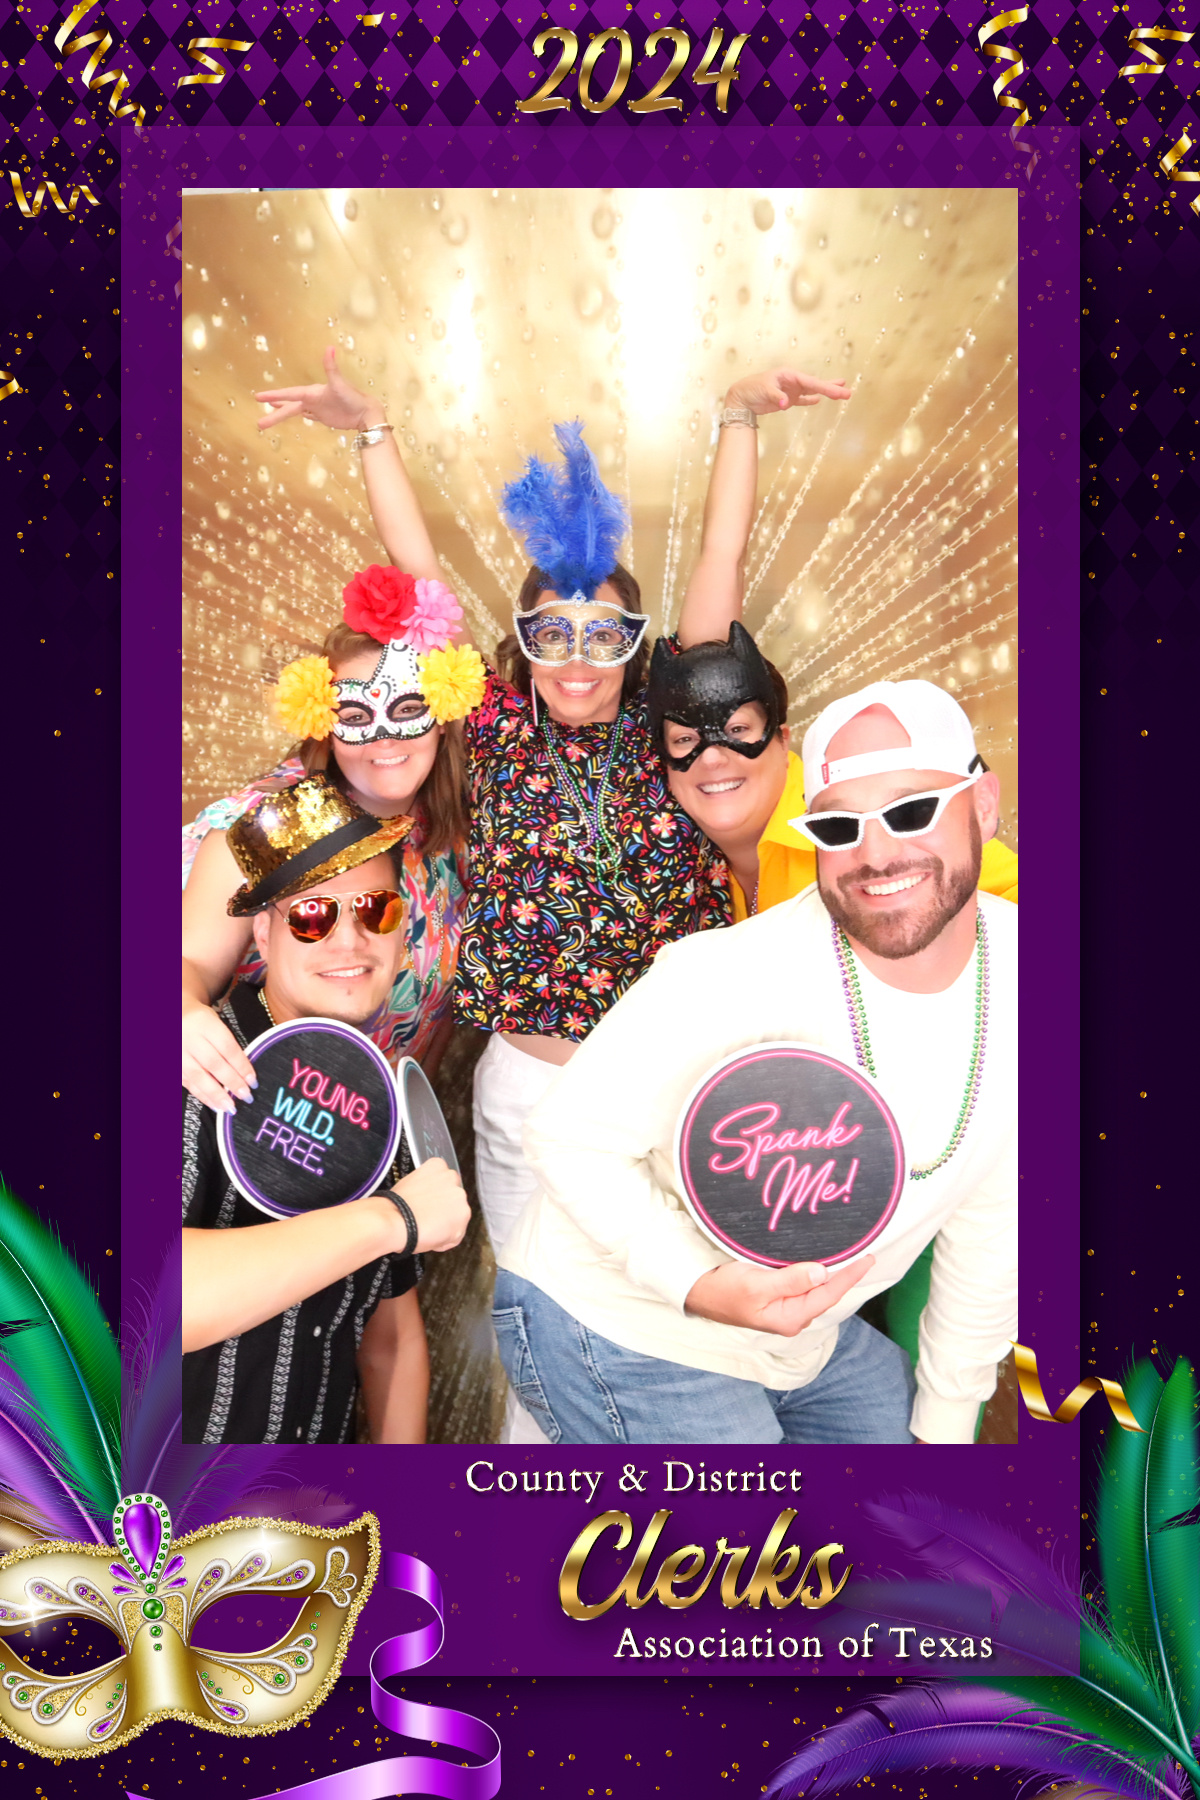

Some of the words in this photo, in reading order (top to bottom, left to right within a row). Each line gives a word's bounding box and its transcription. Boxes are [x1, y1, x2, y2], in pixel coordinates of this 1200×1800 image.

[272, 1086, 335, 1146] WILD.
[288, 1057, 370, 1130] YOUNG.
[255, 1116, 327, 1176] FREE.
[708, 1101, 863, 1180] Spank
[762, 1154, 860, 1231] Me!
